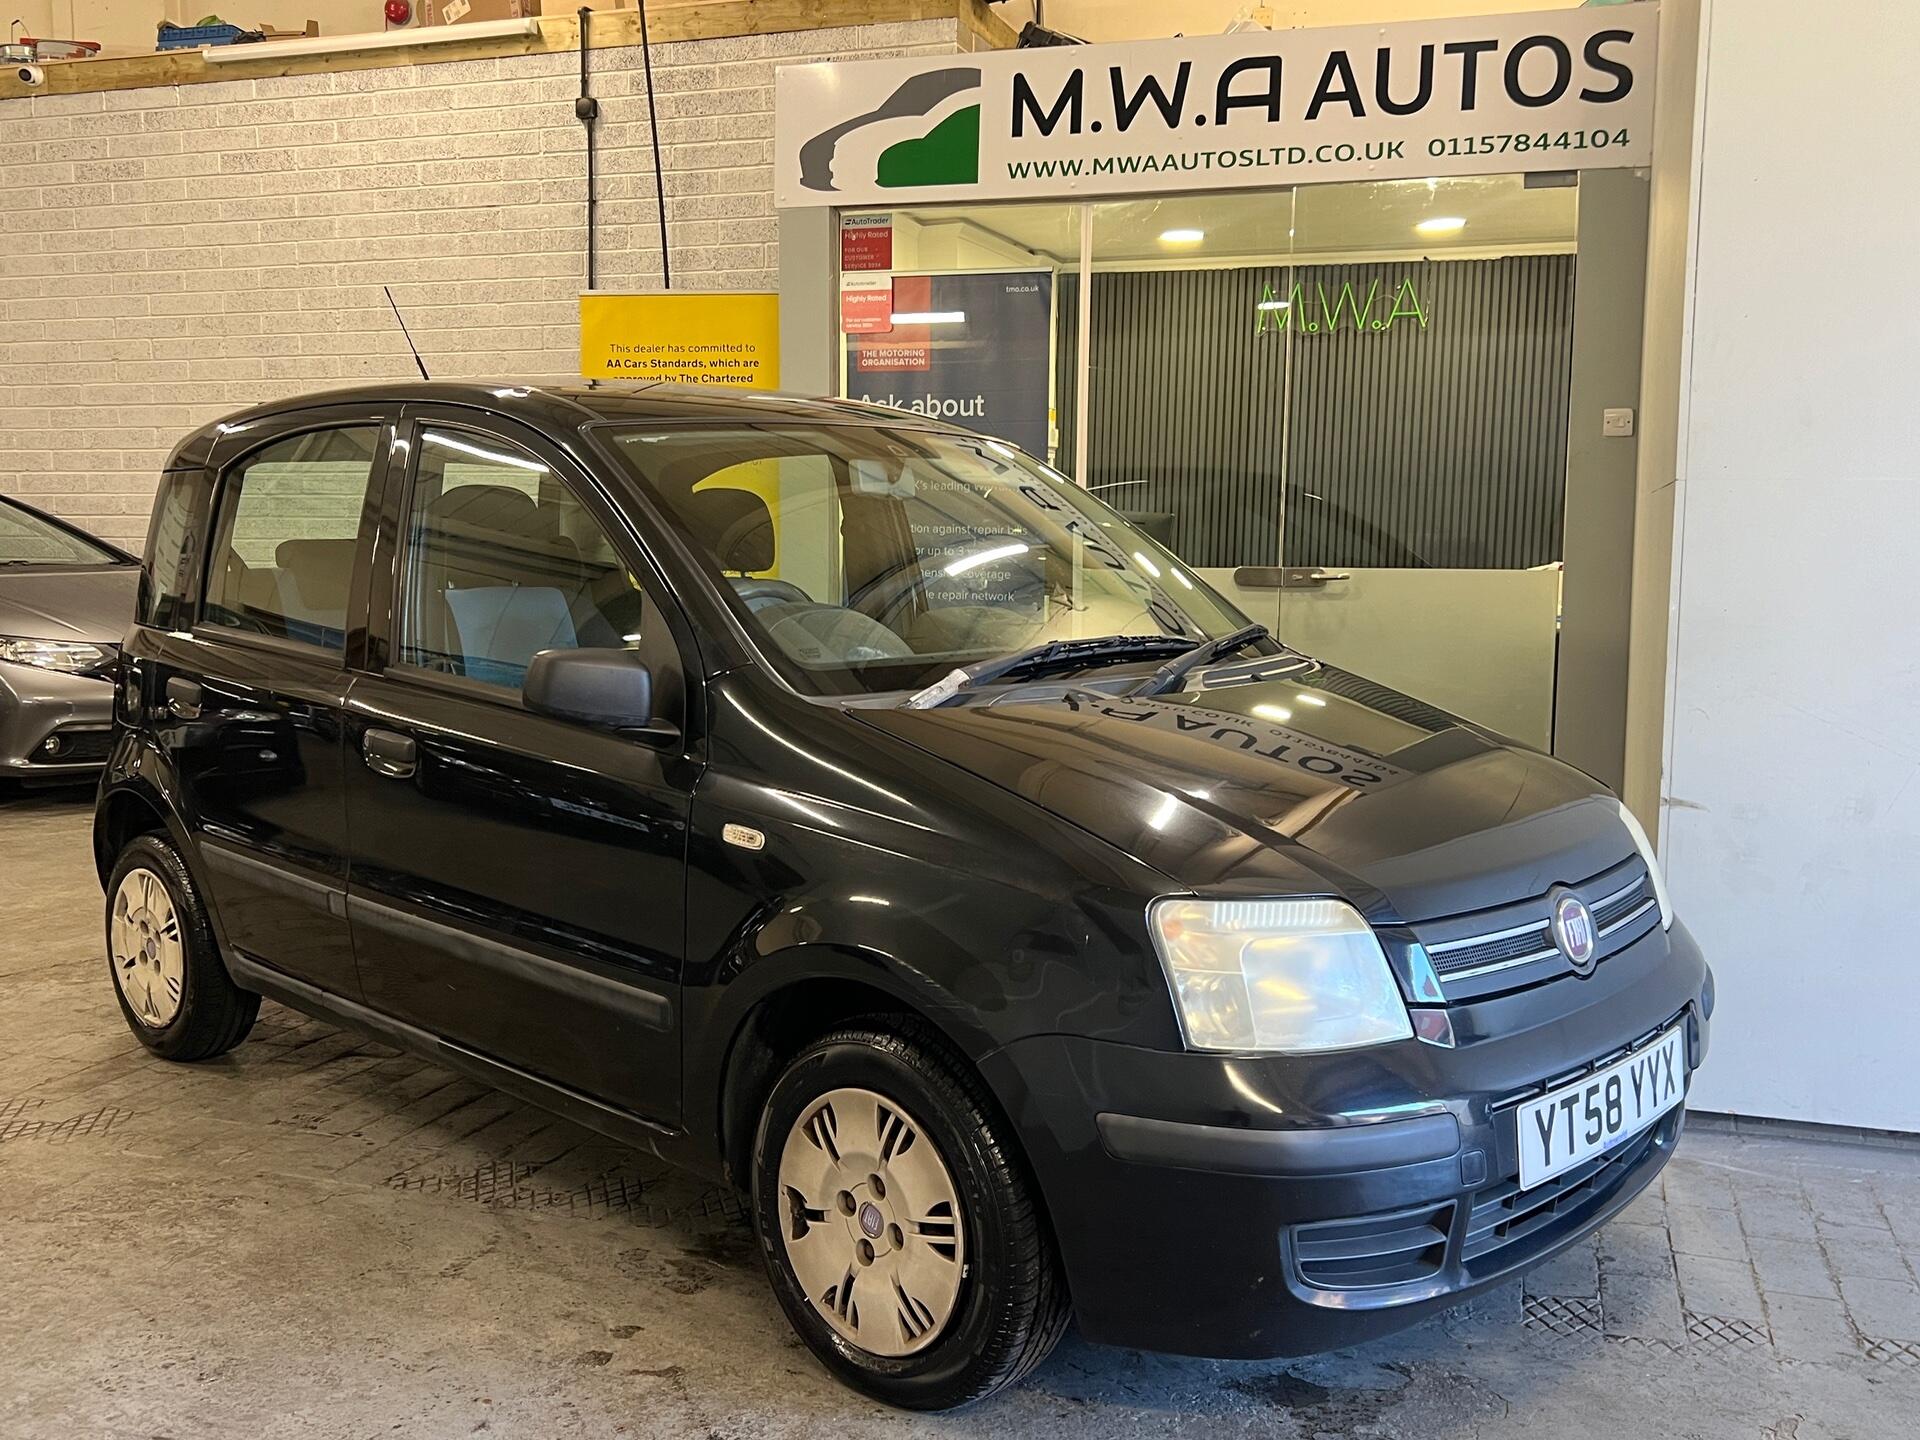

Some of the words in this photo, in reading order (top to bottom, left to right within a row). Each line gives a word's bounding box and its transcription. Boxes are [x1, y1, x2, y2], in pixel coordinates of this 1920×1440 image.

[1011, 55, 1282, 138] M.W.A
[1304, 30, 1634, 121] AUTOS
[1007, 140, 1404, 180] WWW.MWAAUTOSLTD.CO.UK
[1428, 128, 1631, 157] 01157844104
[851, 217, 888, 226] AutoTrader
[1005, 285, 1039, 293] tmo.co.uk
[846, 295, 866, 304] Highly
[1257, 278, 1427, 334] M.W.A
[609, 344, 630, 353] This
[633, 343, 665, 353] dealer
[667, 344, 685, 353] has
[688, 343, 742, 353] committed
[745, 344, 756, 353] to
[862, 350, 878, 358] THE
[879, 349, 925, 358] MOTORING
[606, 359, 622, 368] AA
[624, 359, 647, 368] Cars
[650, 359, 707, 370] Standards,
[709, 359, 741, 368] which
[743, 360, 760, 368] are
[862, 358, 925, 367] ORGANISATION
[664, 374, 677, 382] by
[679, 374, 698, 383] The
[701, 373, 753, 383] Chartered
[911, 393, 985, 417] about
[931, 480, 970, 493] leading
[932, 524, 970, 536] against
[974, 525, 1004, 537] repair
[928, 547, 941, 557] up
[944, 546, 954, 555] to
[958, 546, 965, 555] 3
[966, 570, 1011, 581] overage
[938, 590, 969, 601] repair
[971, 592, 1015, 602] network
[1535, 1074, 1623, 1167] YT58
[1630, 1040, 1676, 1119] YYX
